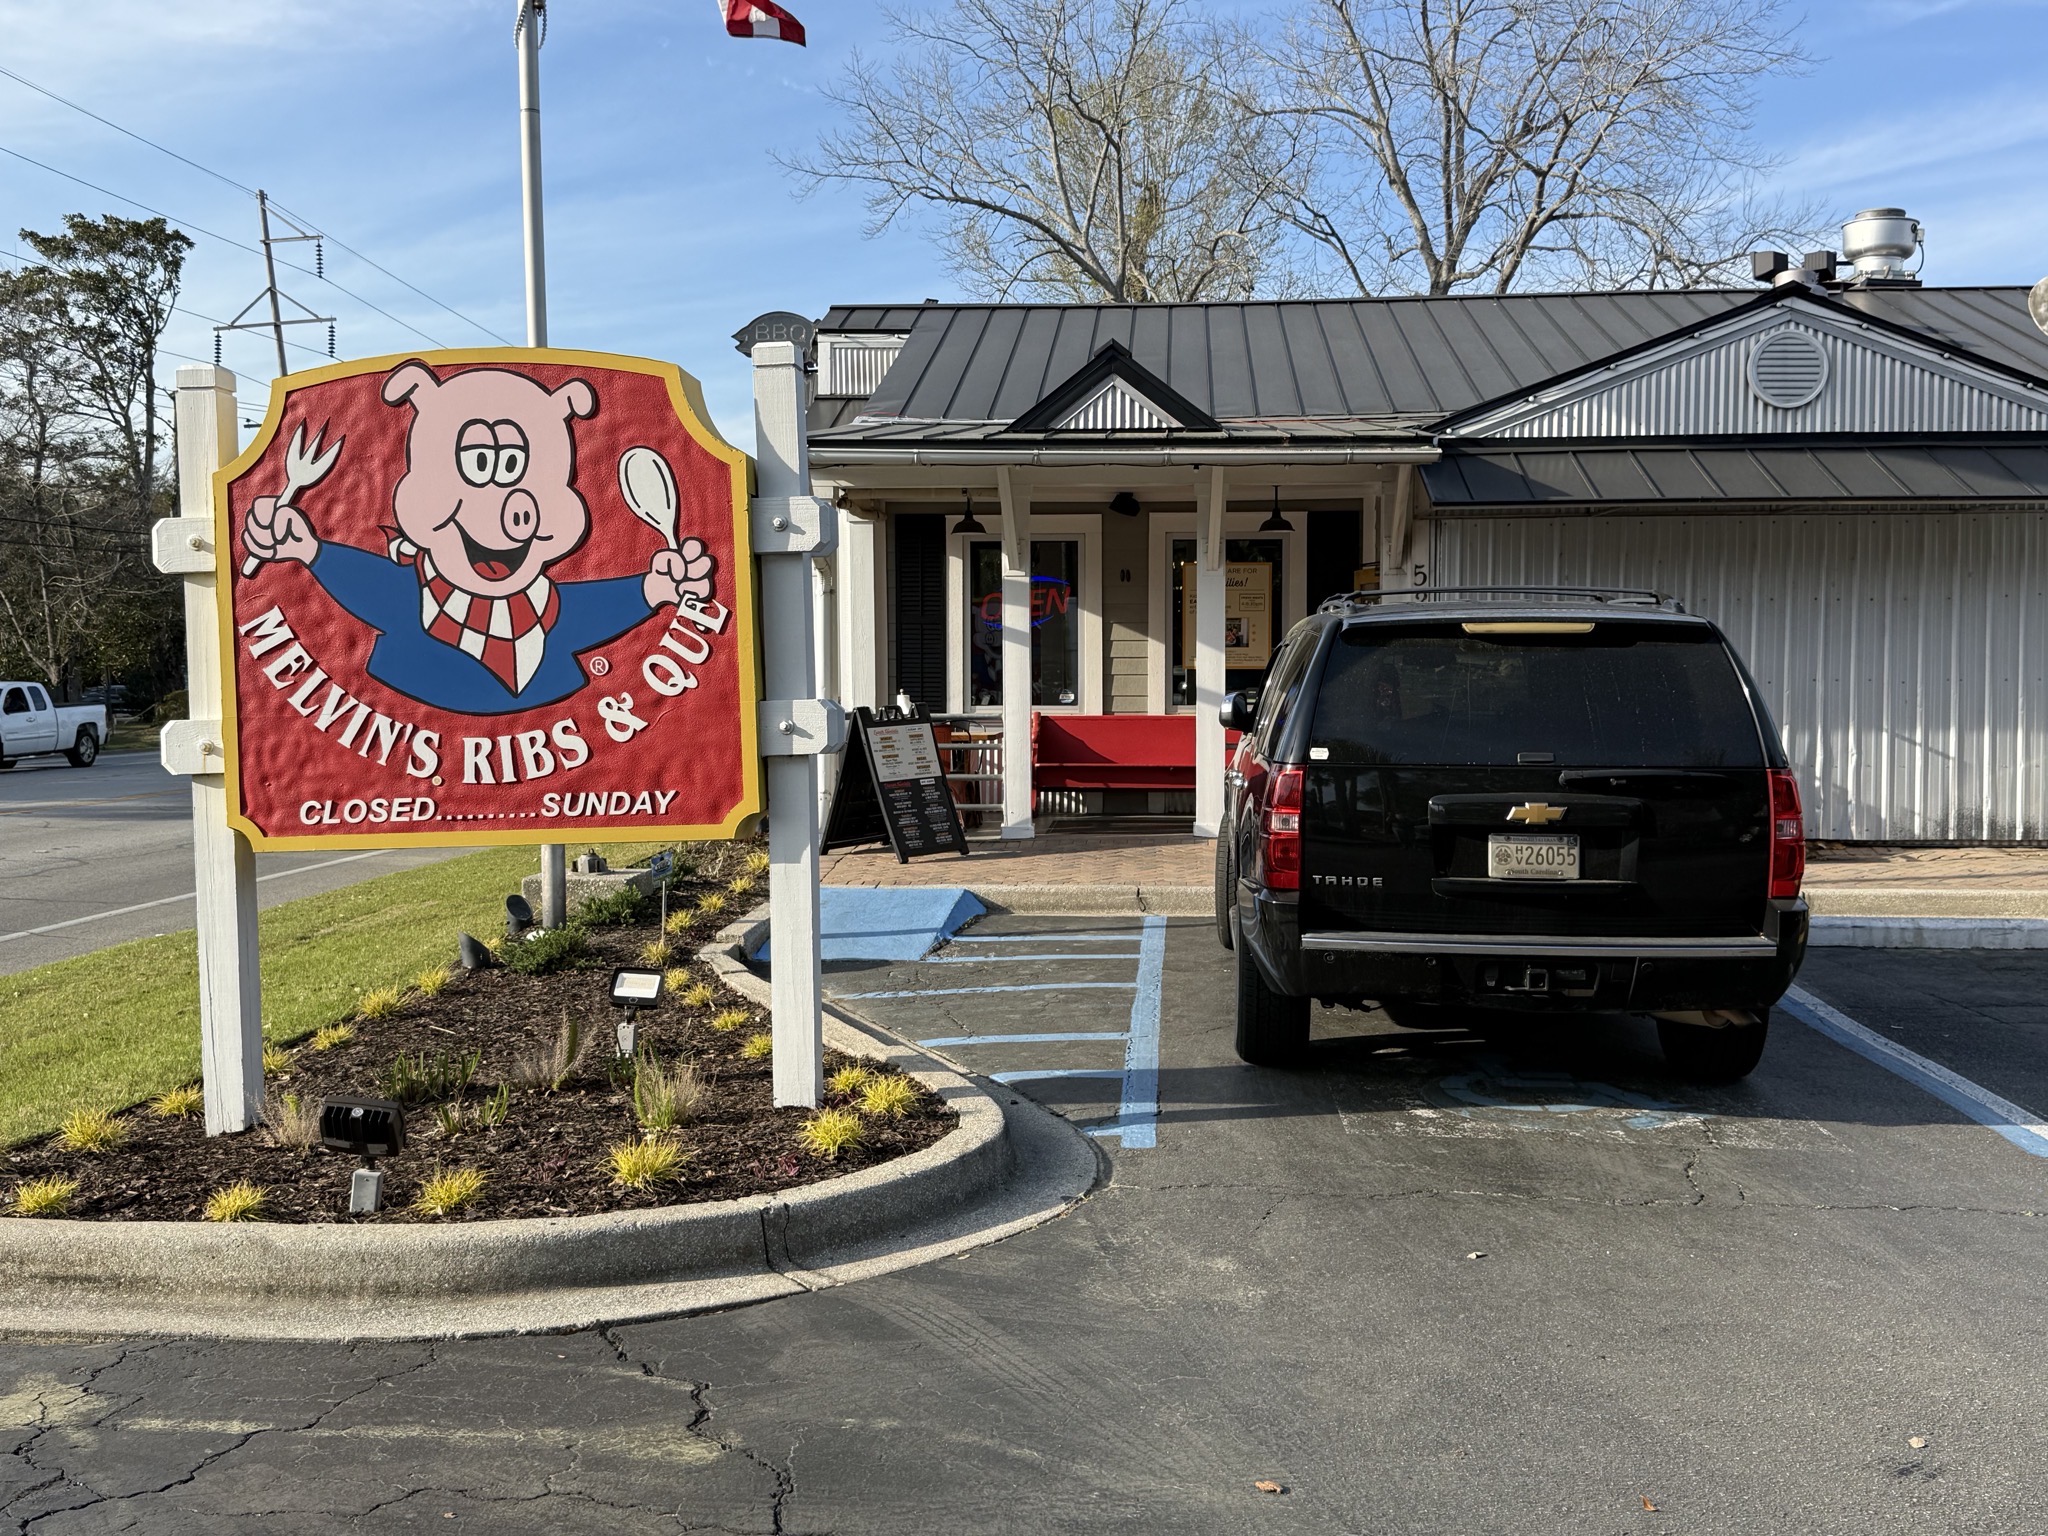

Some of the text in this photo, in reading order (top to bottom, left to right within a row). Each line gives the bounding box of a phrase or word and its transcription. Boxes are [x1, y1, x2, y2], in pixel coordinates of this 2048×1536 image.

[755, 323, 806, 342] BBQ
[980, 586, 1072, 621] OEN
[239, 592, 729, 784] MELVIN'S RIBS & QUE
[1312, 875, 1383, 887] TAHOE
